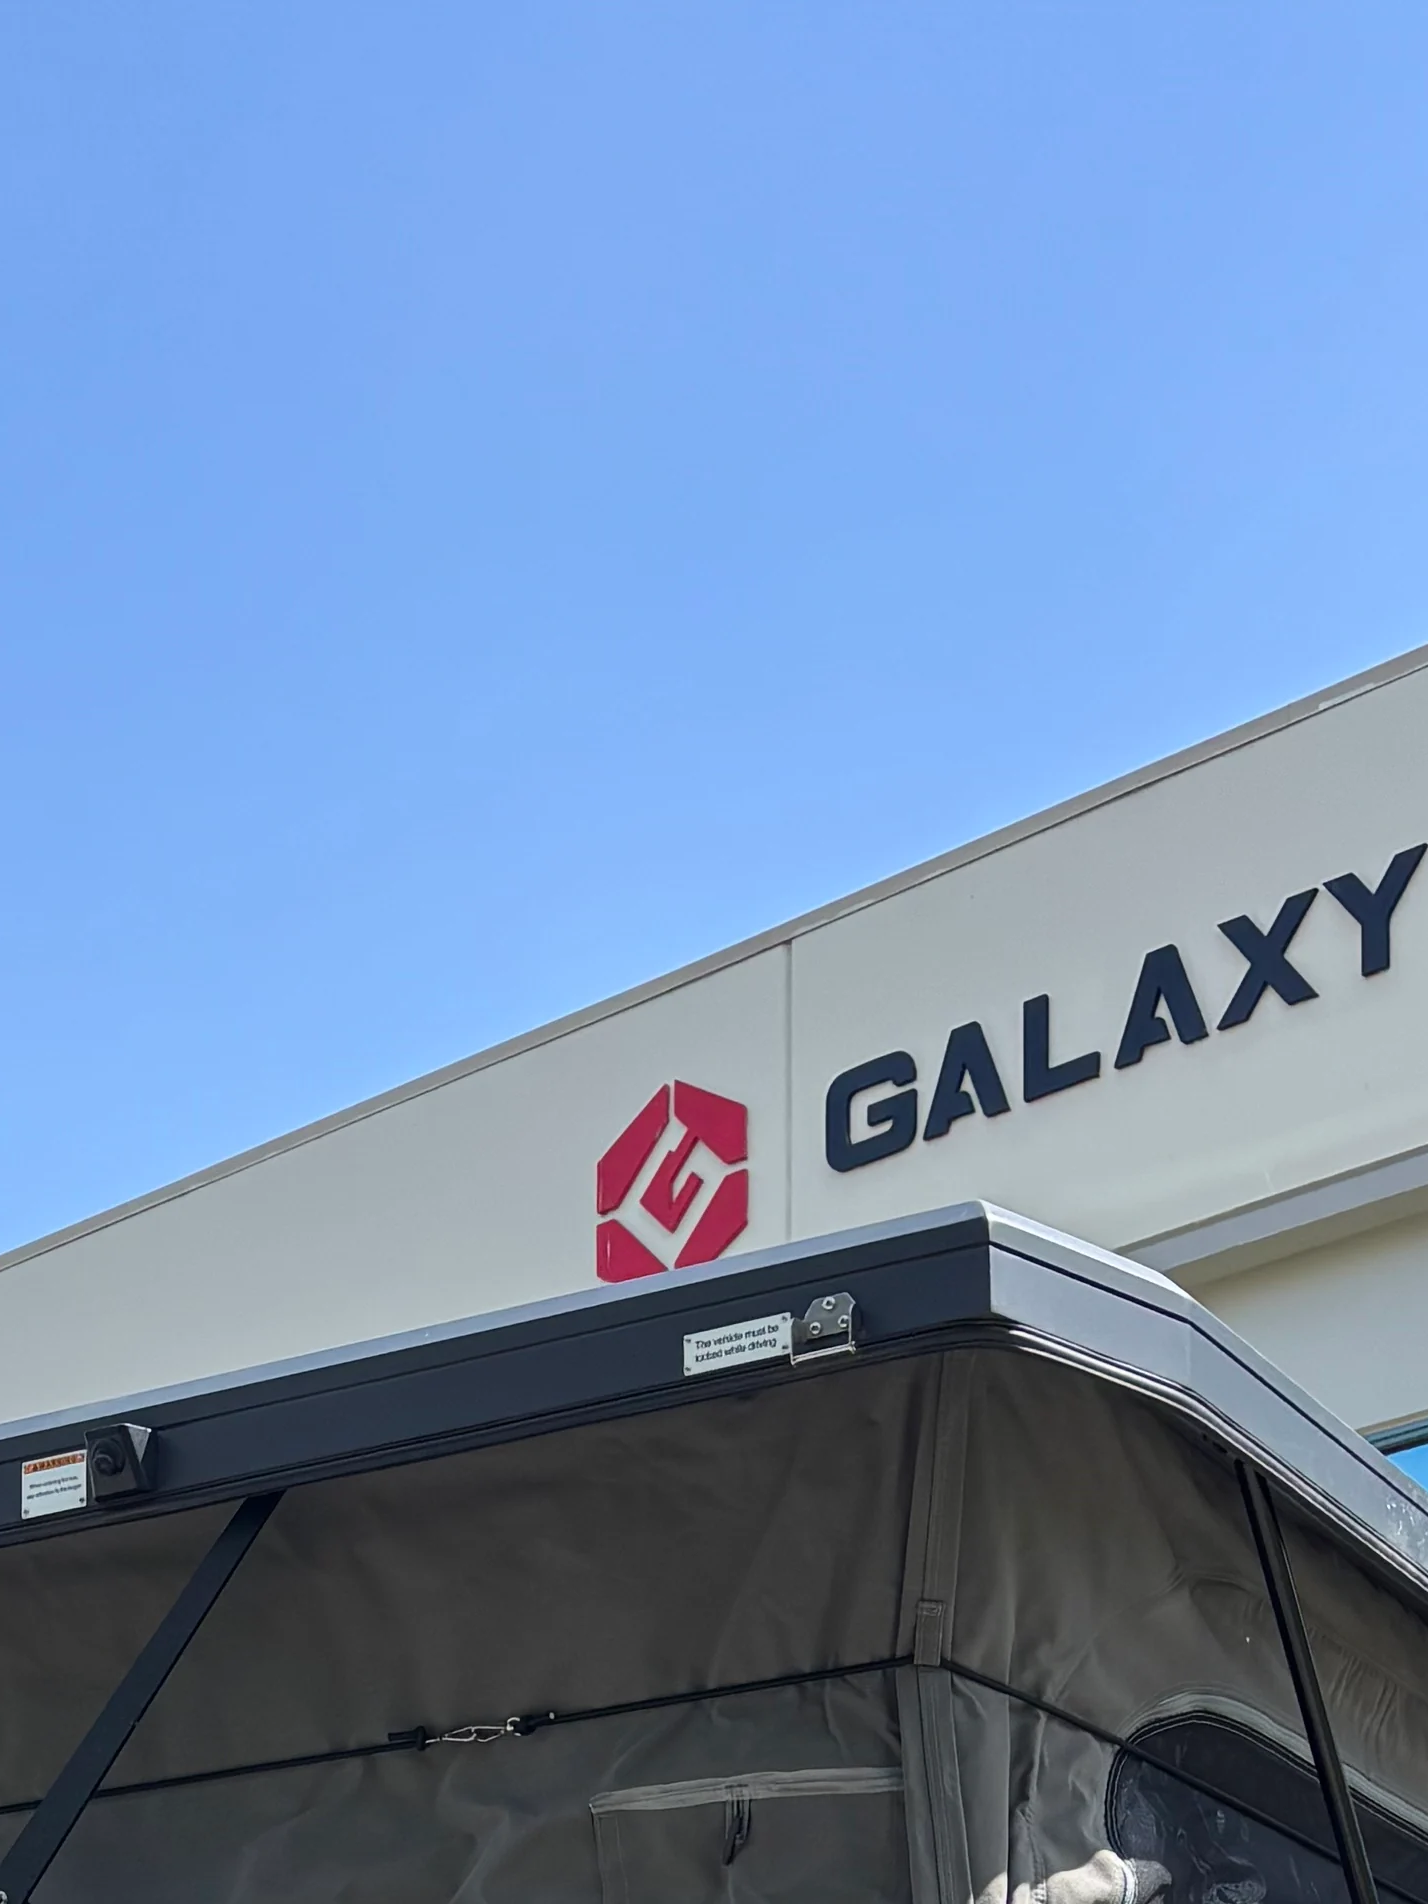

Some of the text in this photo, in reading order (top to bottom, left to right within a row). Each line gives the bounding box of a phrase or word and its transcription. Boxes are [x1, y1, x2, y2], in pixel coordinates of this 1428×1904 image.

[824, 844, 1428, 1172] GALAXY
[695, 1340, 711, 1349] The
[745, 1326, 766, 1339] must
[767, 1325, 779, 1333] be
[747, 1338, 777, 1350] driving
